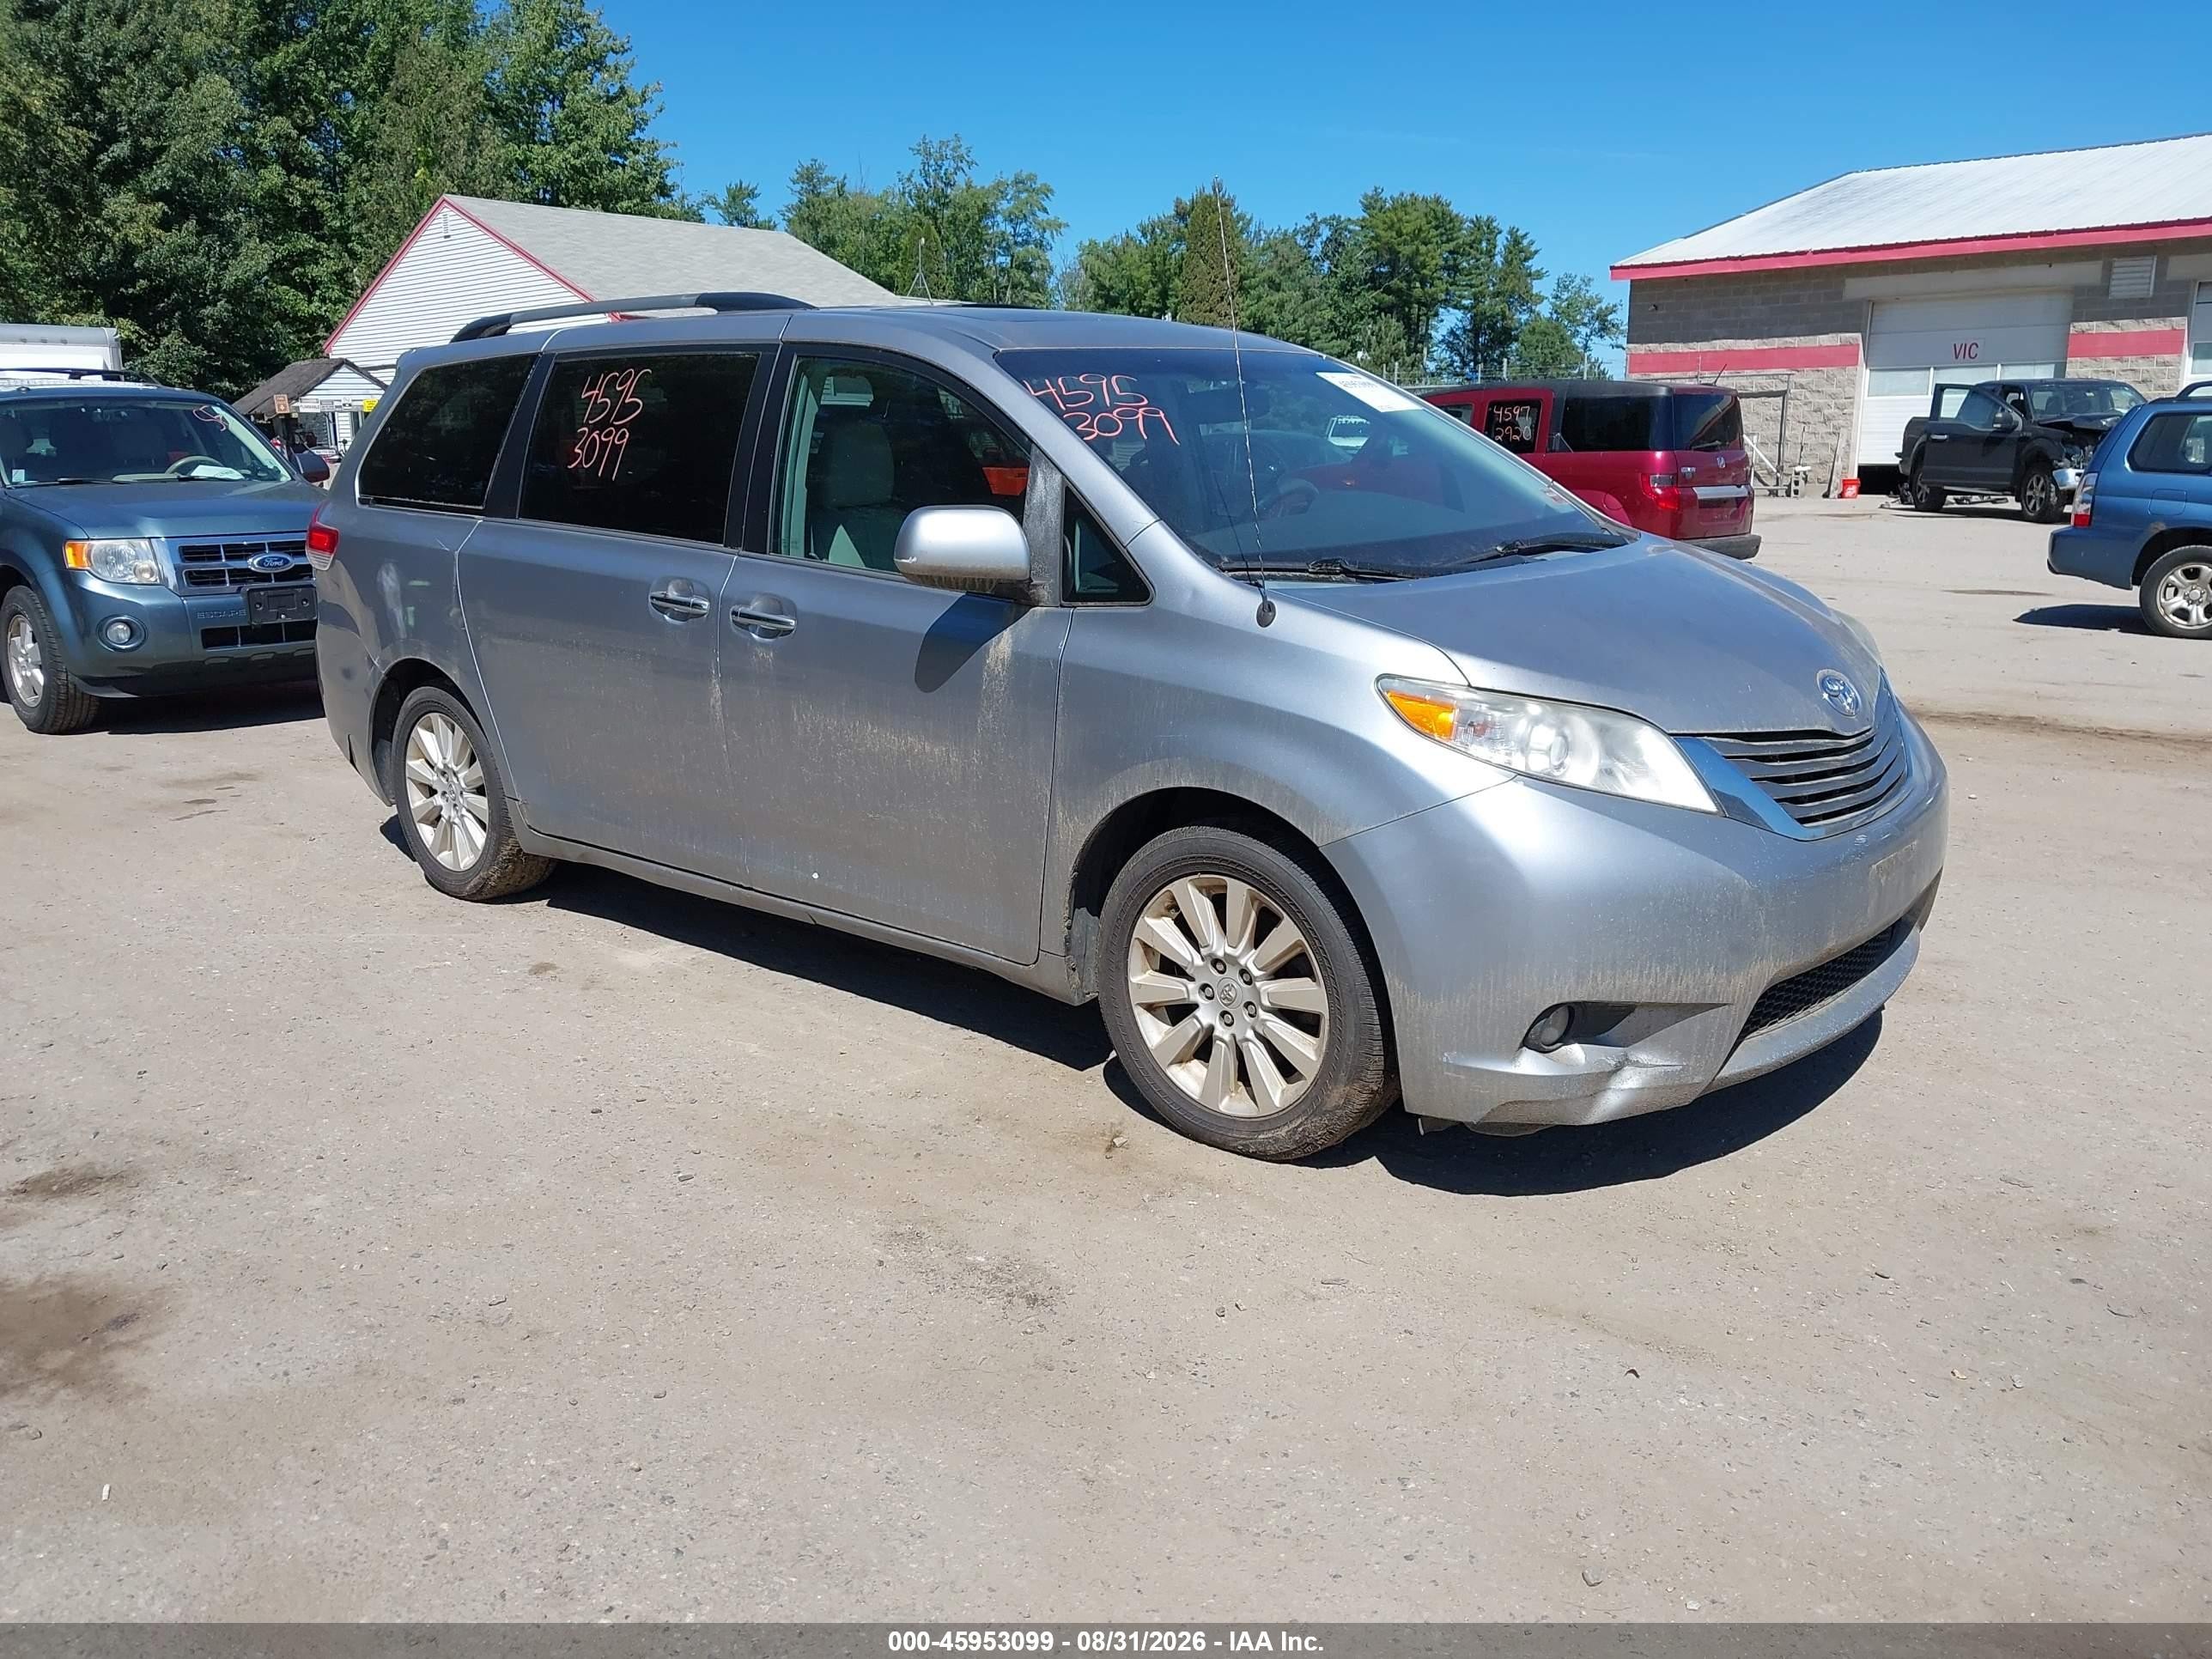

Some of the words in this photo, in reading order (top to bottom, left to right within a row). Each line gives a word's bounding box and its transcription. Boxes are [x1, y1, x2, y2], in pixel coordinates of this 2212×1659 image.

[1953, 342, 1979, 360] VIC
[581, 368, 653, 425] 4595
[1022, 373, 1149, 410] 4595
[1063, 407, 1181, 446] 3099
[1493, 405, 1530, 423] 4597
[1494, 425, 1532, 442] 2920
[567, 427, 630, 482] 3099
[263, 557, 284, 567] Ford
